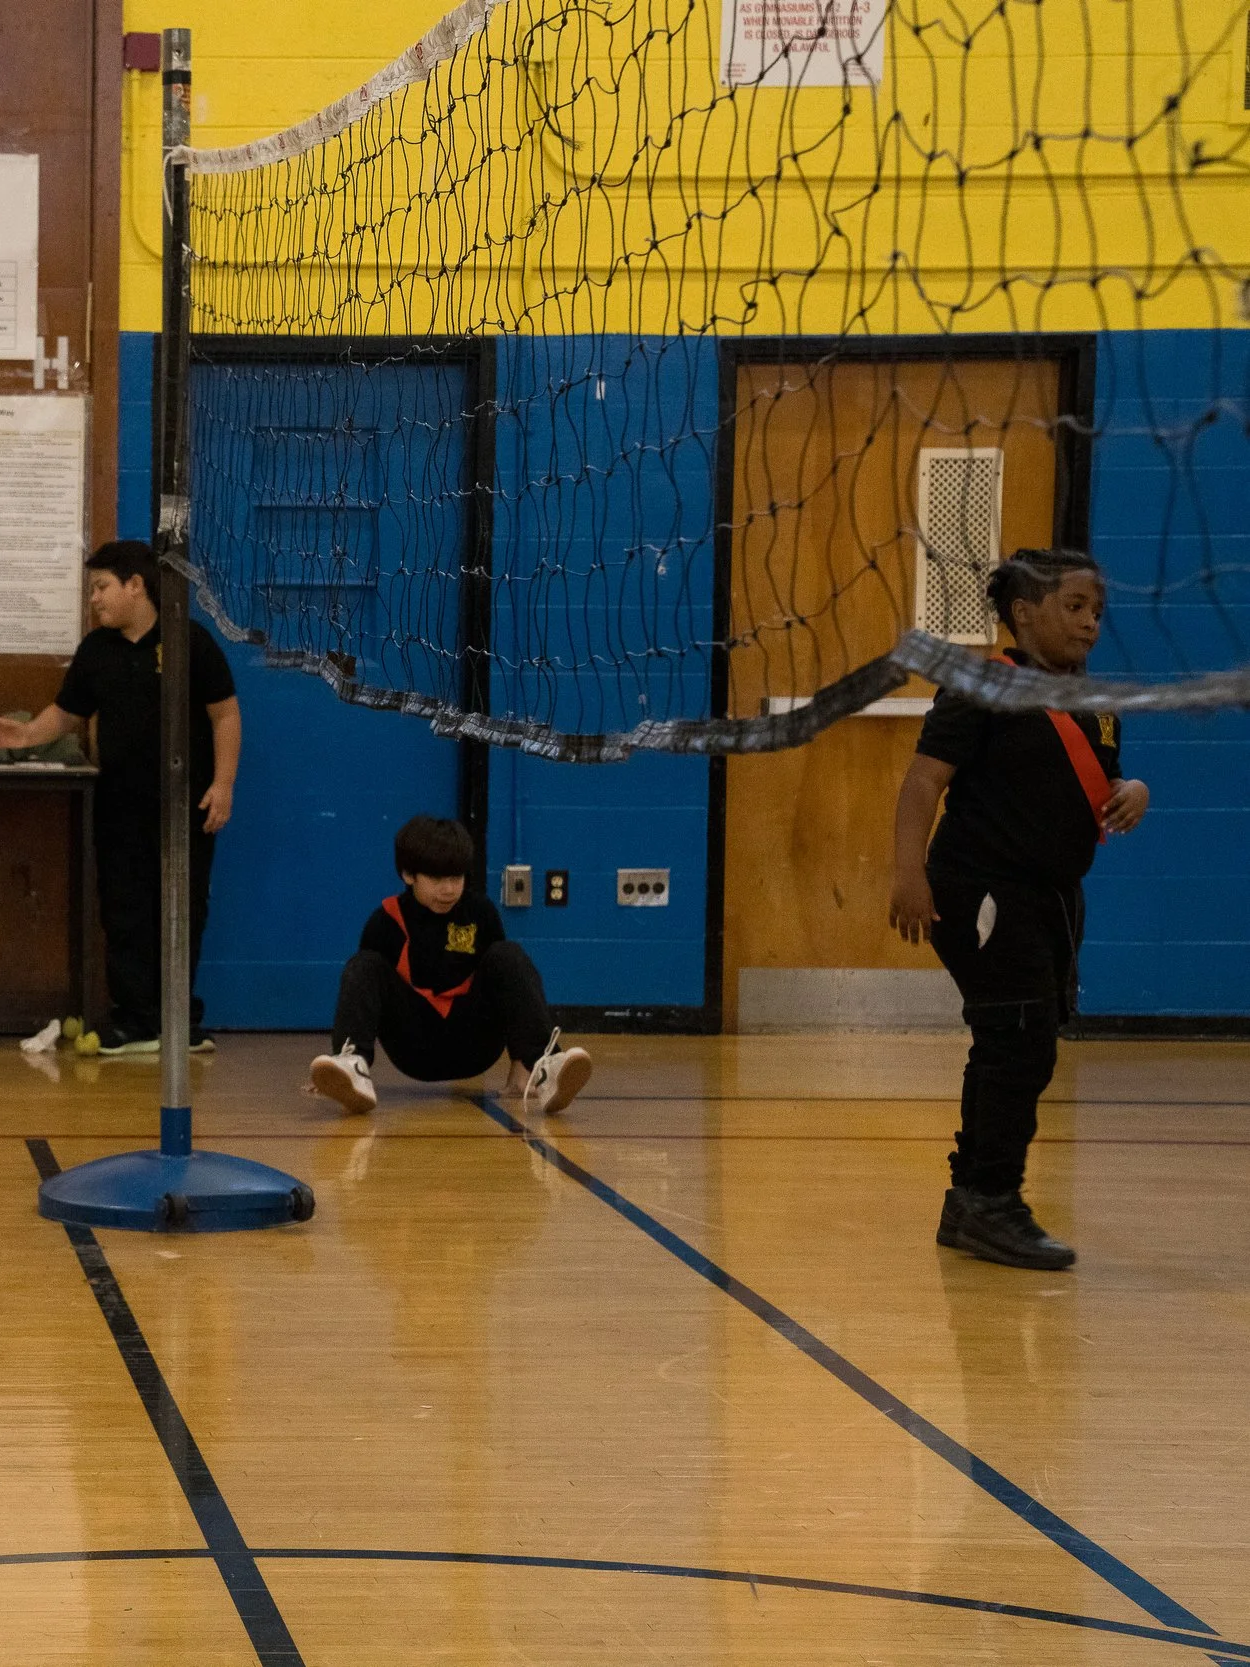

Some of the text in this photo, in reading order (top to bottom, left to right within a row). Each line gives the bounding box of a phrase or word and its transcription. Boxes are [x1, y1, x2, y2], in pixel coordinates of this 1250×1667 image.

[740, 4, 751, 12] AS
[754, 4, 814, 12] GYMNASIUMS
[743, 17, 769, 25] WHEN
[772, 17, 813, 26] MOVABLE
[745, 31, 752, 39] IS
[34, 336, 69, 390] H
